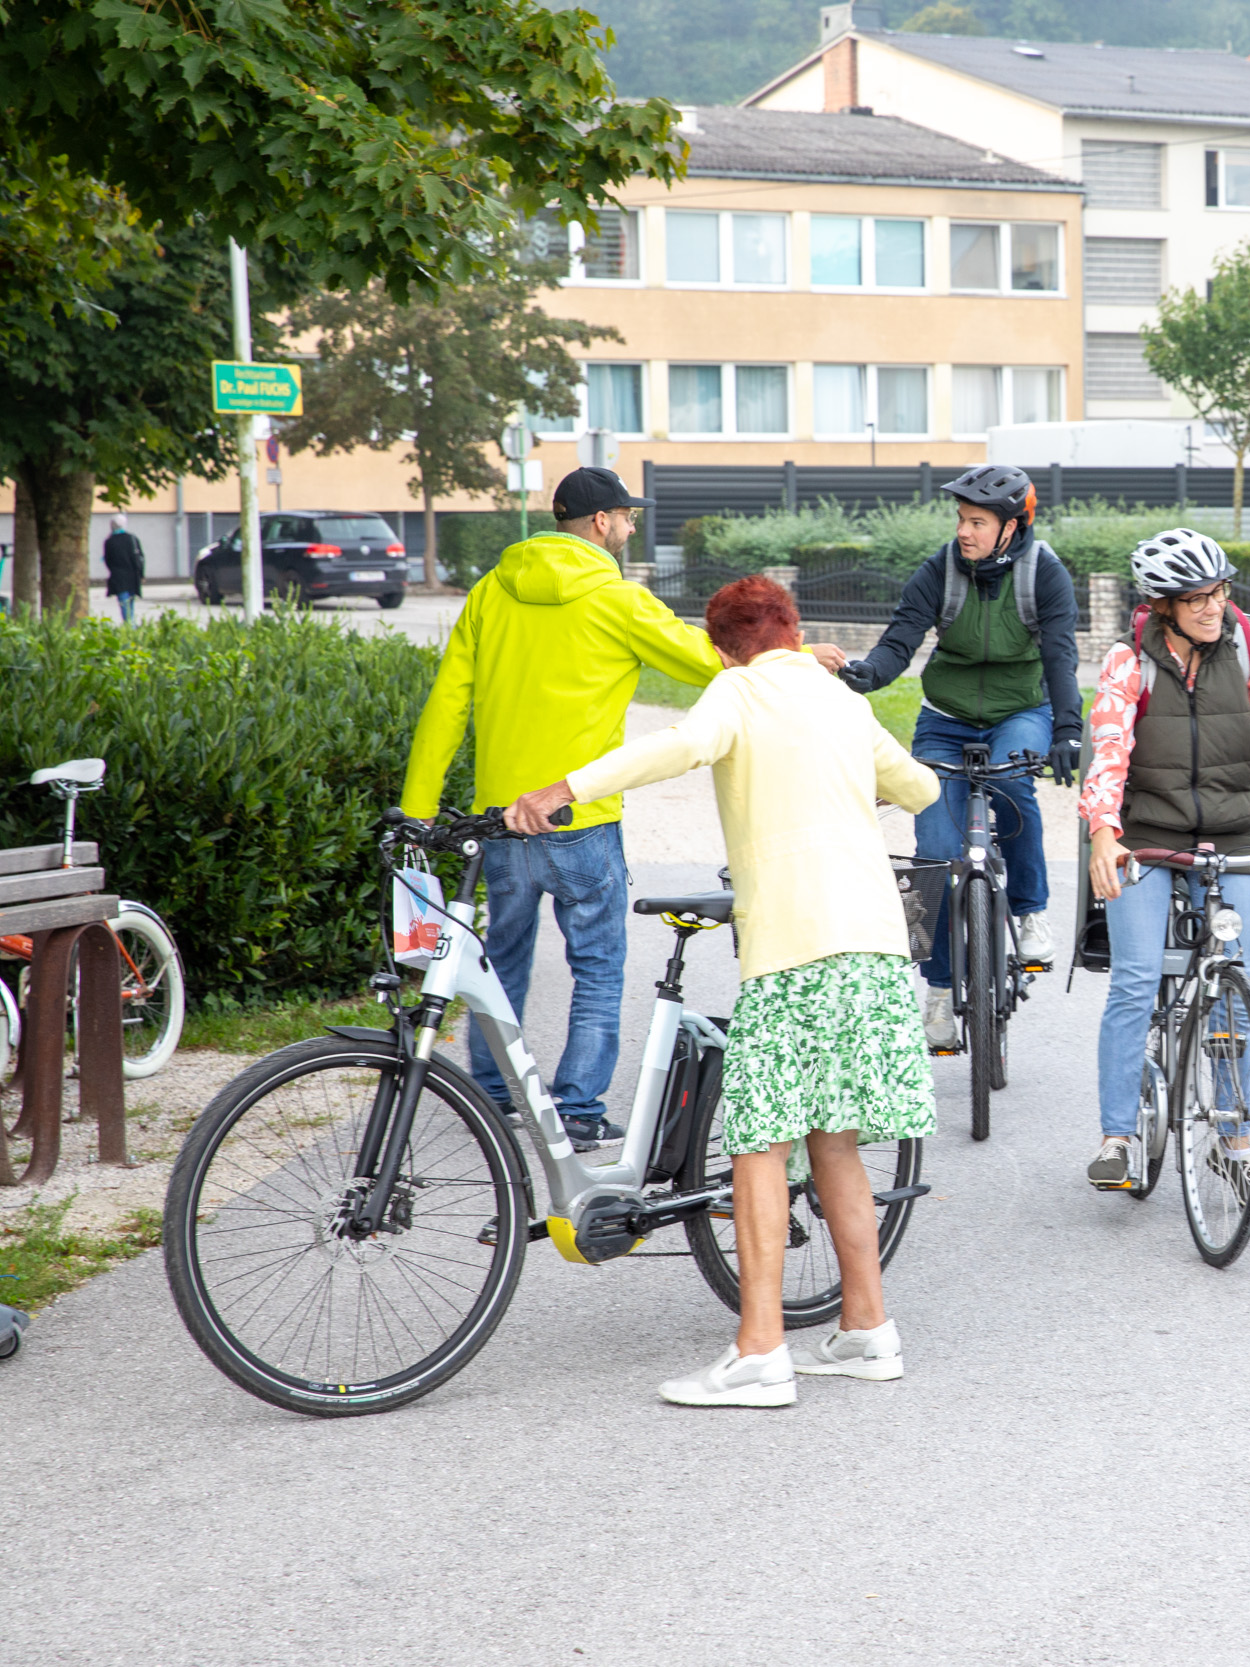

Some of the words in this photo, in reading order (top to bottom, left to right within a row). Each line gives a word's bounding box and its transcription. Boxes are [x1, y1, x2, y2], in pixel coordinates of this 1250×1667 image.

[220, 380, 236, 394] Dr.
[237, 380, 258, 395] Paul
[260, 382, 291, 397] FUCHS
